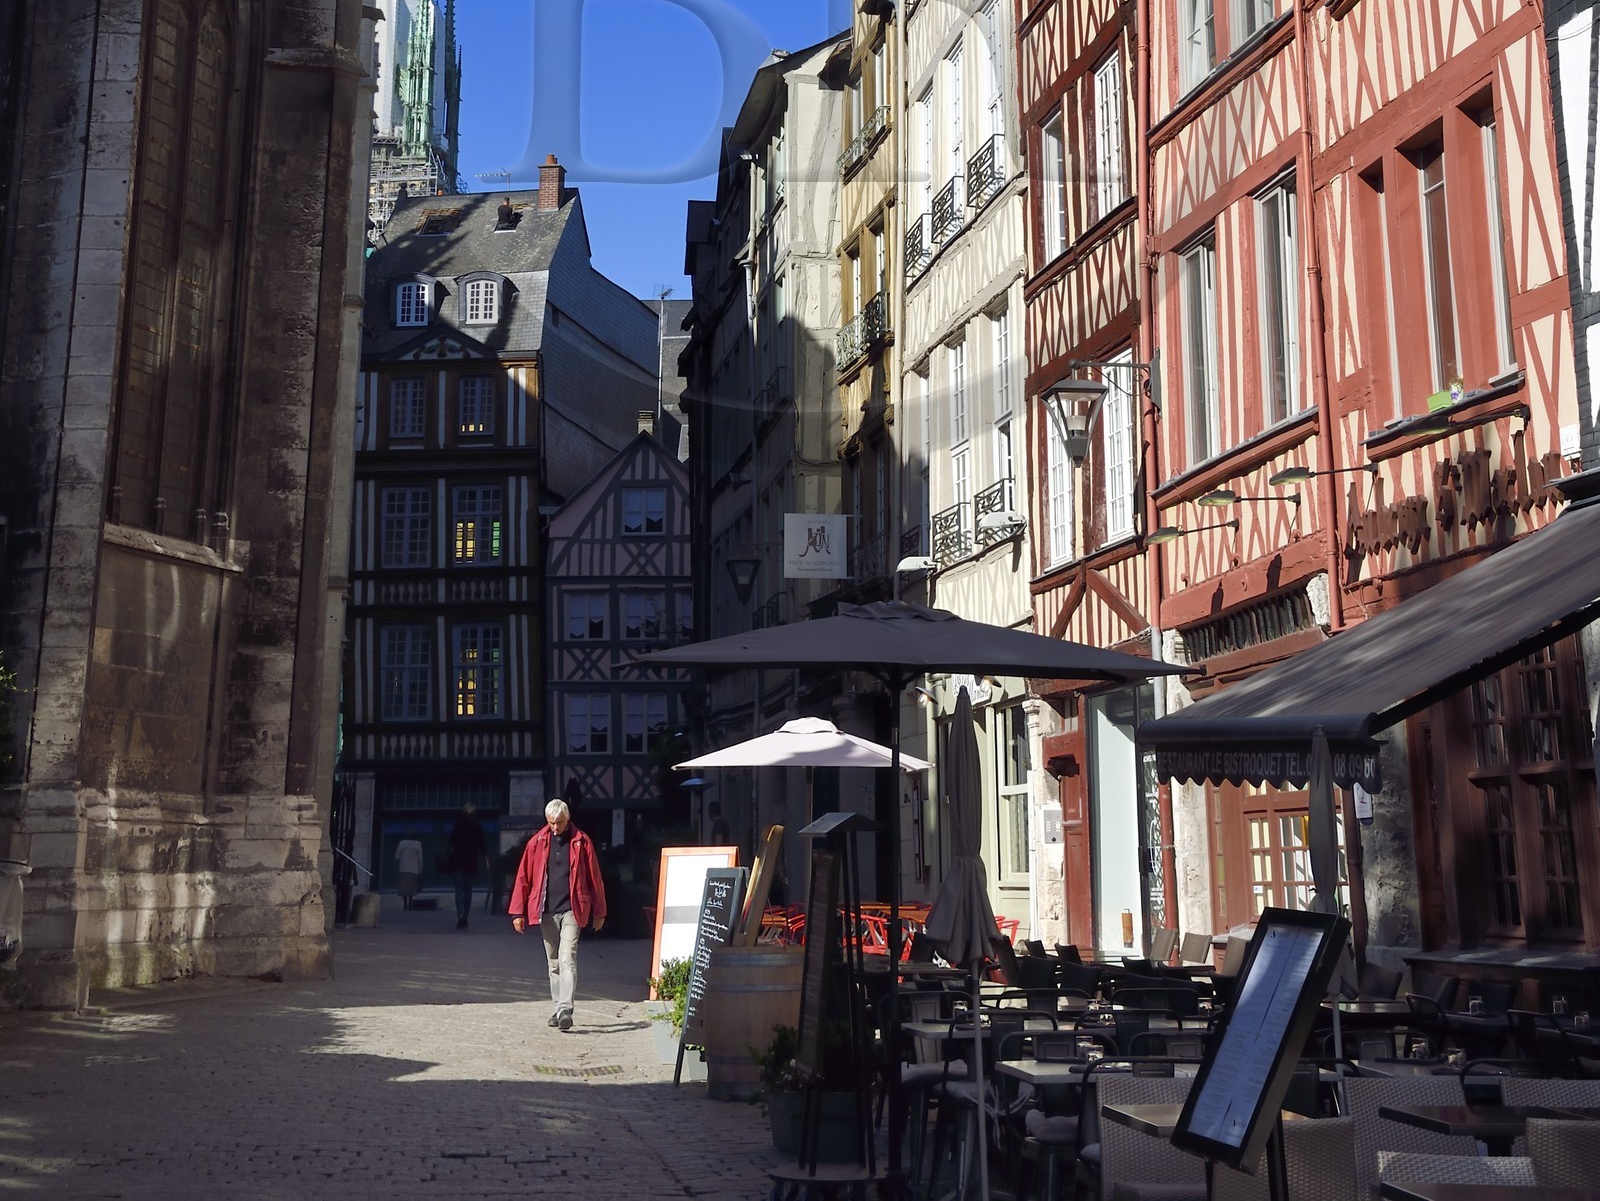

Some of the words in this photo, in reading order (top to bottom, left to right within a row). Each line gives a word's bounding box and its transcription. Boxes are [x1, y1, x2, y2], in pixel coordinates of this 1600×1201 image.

[1212, 752, 1222, 774] LE
[1224, 752, 1283, 777] BISTROQUET
[1334, 753, 1346, 777] 08
[1348, 753, 1362, 778] 09
